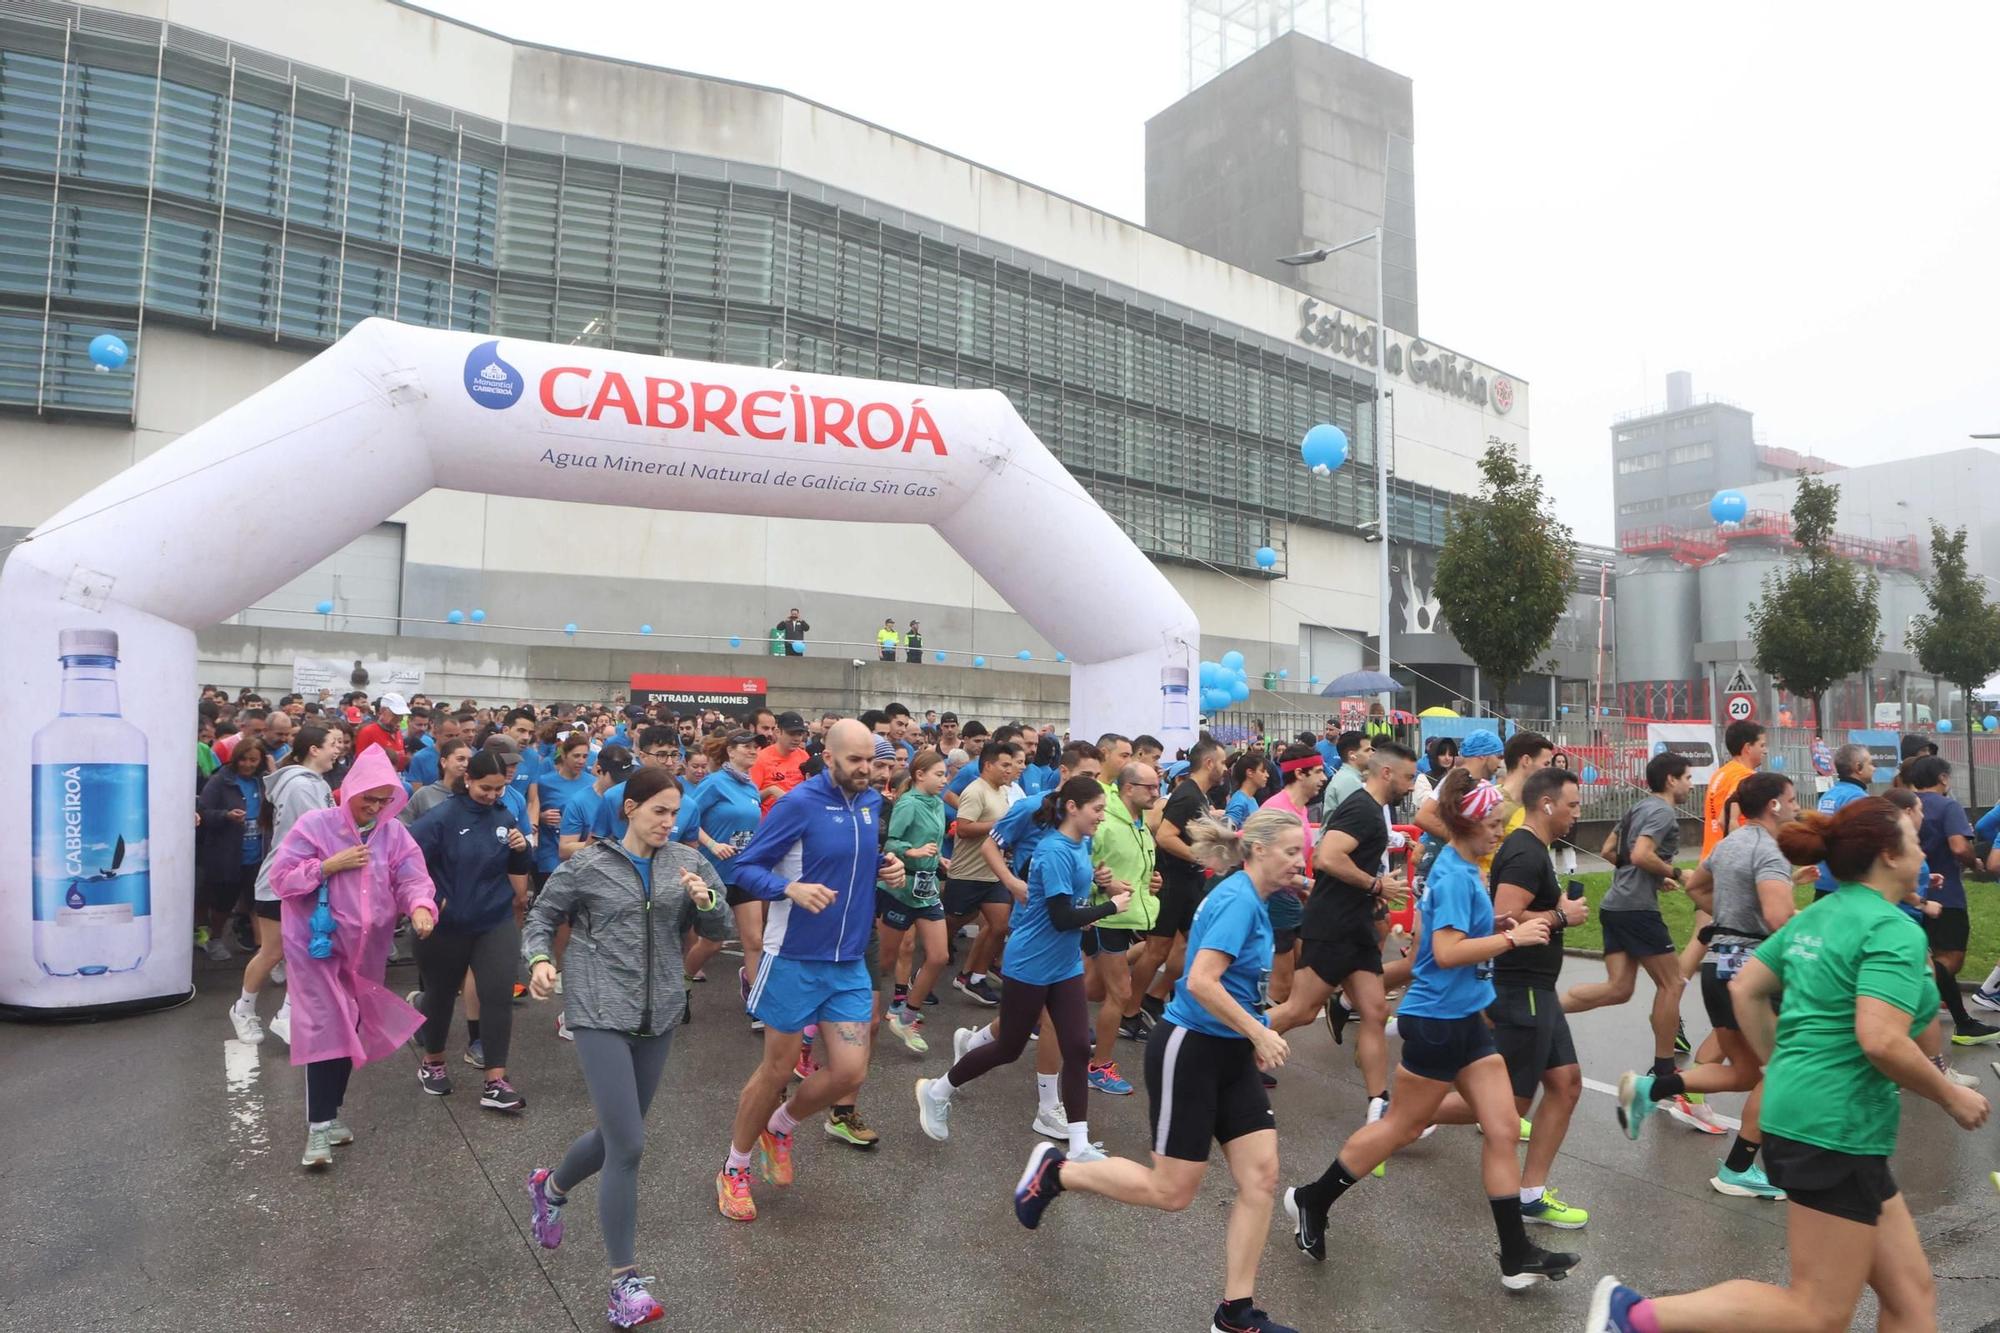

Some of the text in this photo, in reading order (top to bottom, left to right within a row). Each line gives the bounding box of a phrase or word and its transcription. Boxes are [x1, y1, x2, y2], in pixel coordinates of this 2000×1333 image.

[1406, 338, 1489, 407] Galicia
[472, 377, 514, 390] Manantial
[540, 448, 939, 498] Agua Mineral Natural de Galicia Sin Gas
[648, 693, 749, 705] ENTRADA CAMIONES
[1731, 702, 1749, 714] 20
